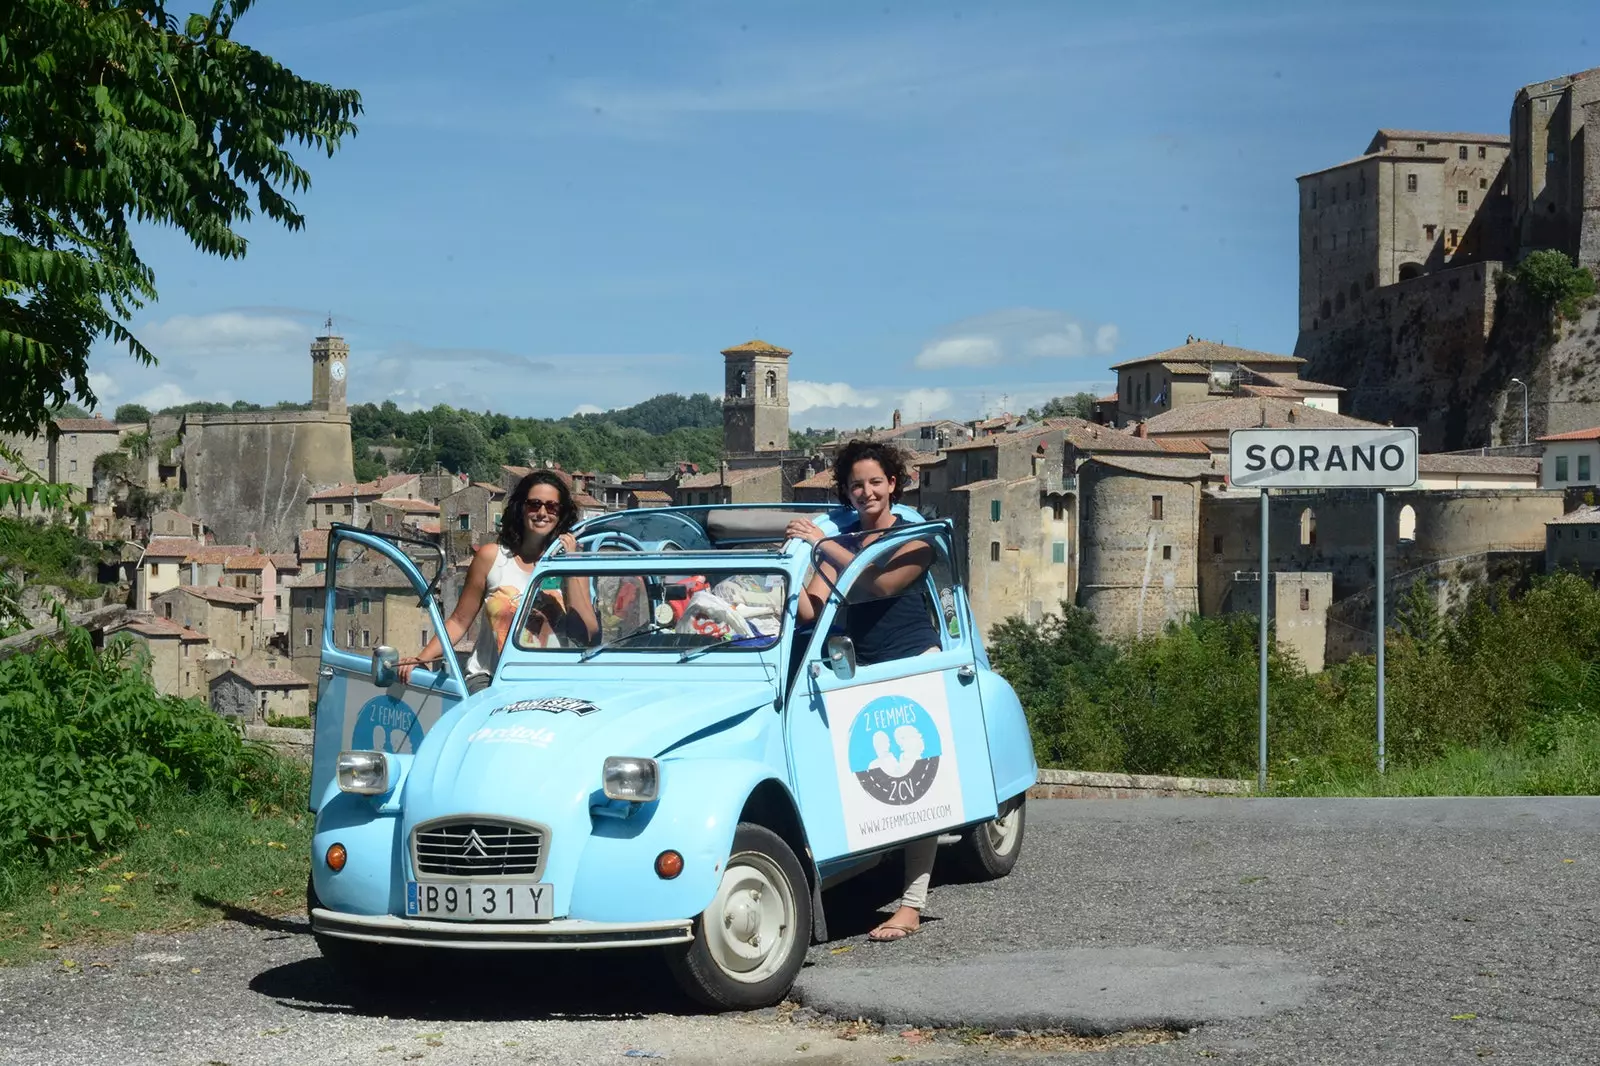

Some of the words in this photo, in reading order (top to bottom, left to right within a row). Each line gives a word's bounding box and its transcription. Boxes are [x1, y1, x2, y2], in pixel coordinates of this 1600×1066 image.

[1244, 444, 1405, 472] SORANO
[370, 704, 376, 722] 2
[378, 706, 412, 731] FEMMES
[864, 712, 872, 731] 2
[873, 703, 917, 729] FEMMES
[888, 778, 915, 801] 2CV
[859, 804, 952, 836] WWW.2FEMMESEN2CV.COM
